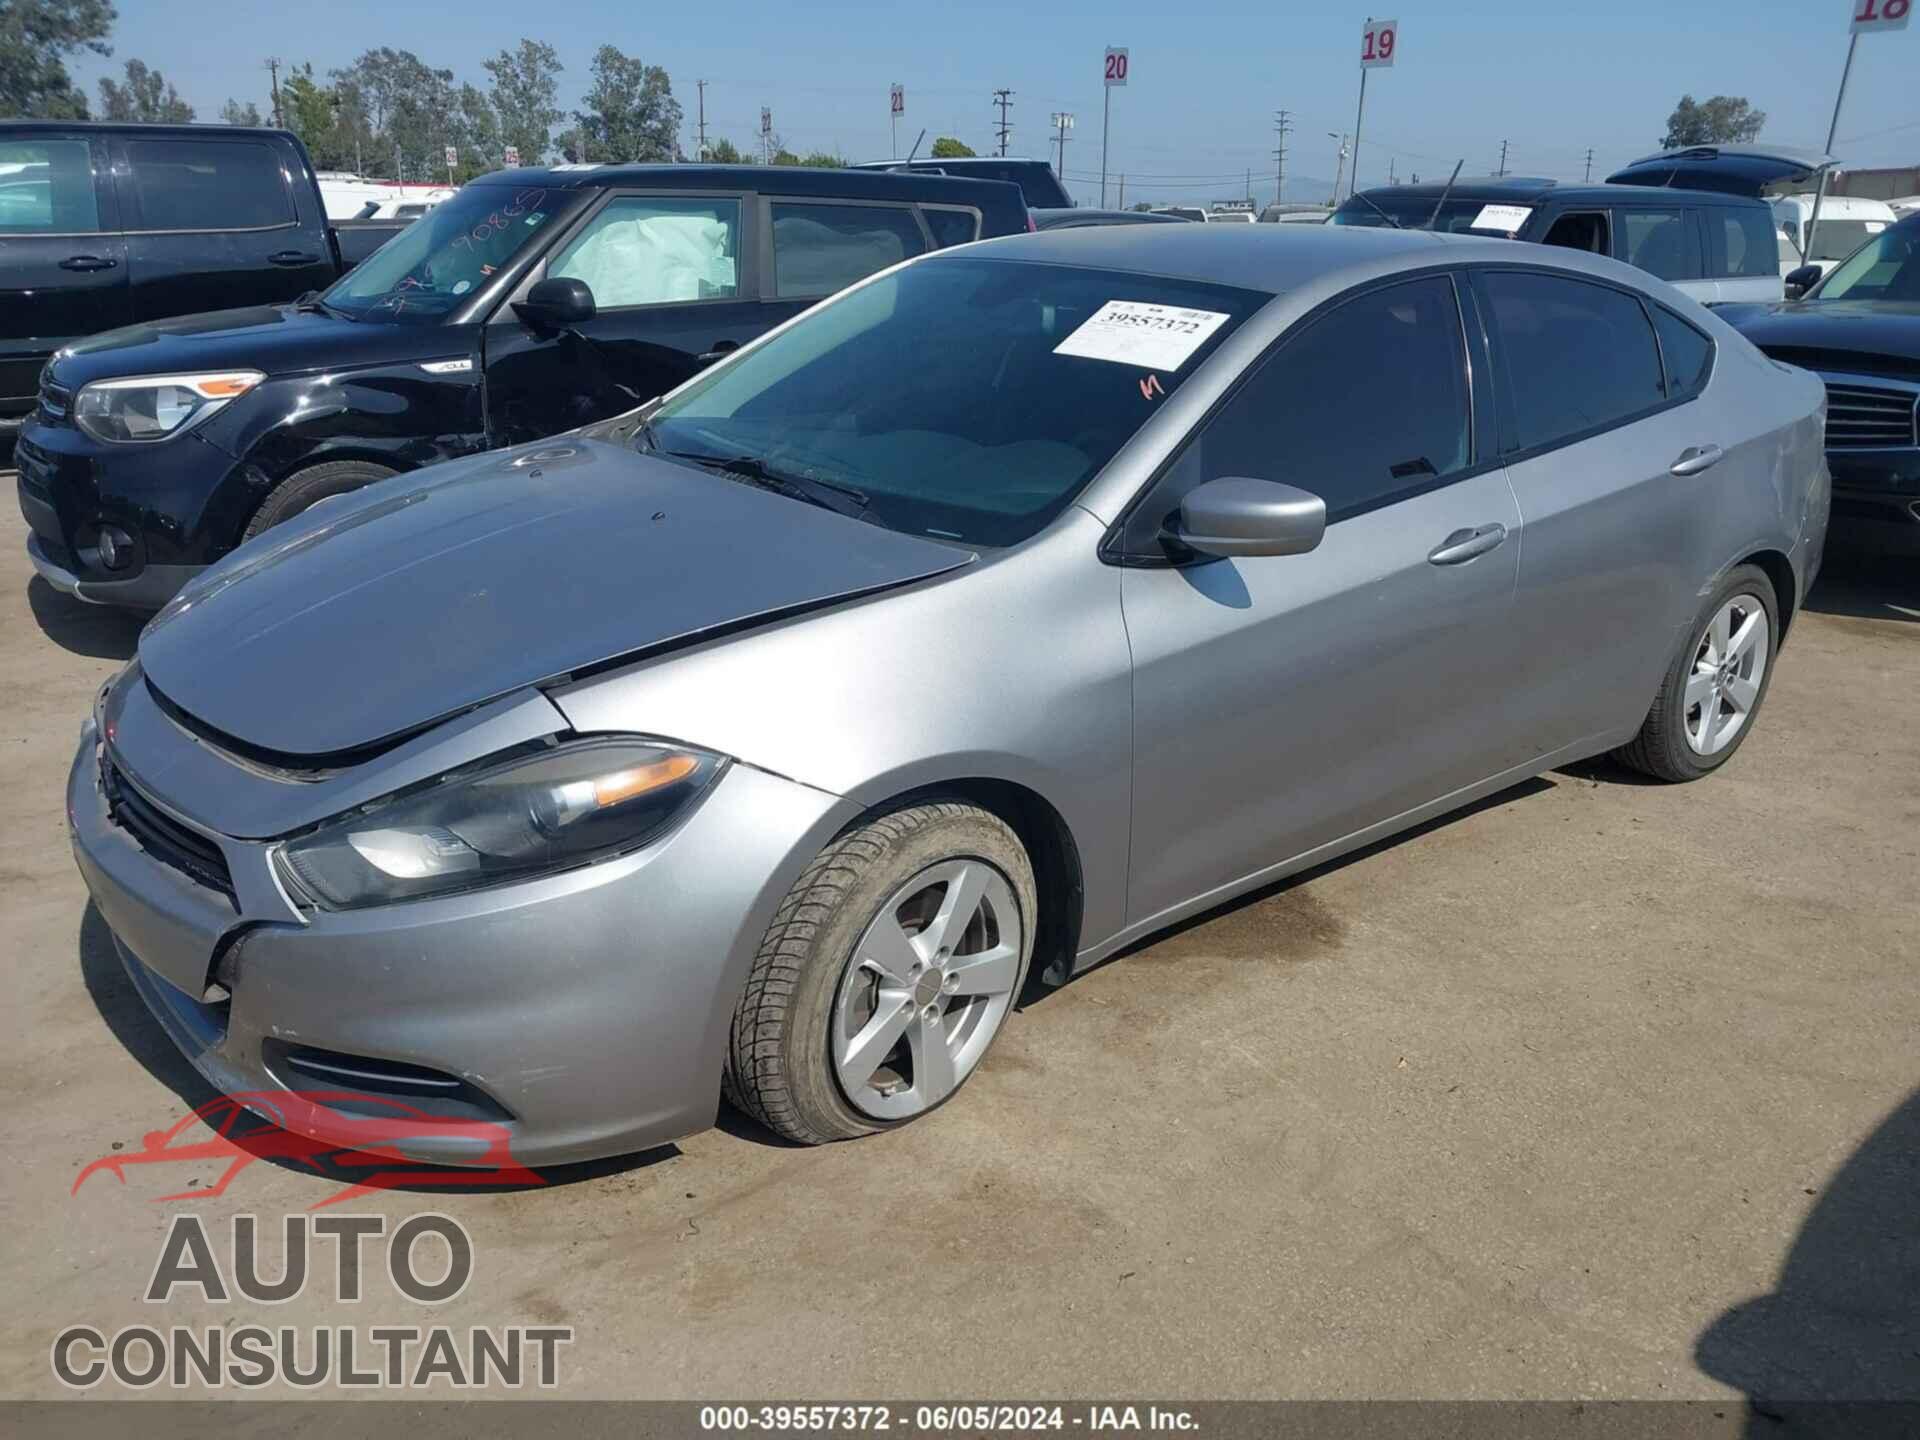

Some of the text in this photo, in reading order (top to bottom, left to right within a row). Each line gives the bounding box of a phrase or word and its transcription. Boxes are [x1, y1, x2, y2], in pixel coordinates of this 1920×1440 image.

[1362, 29, 1394, 60] 19
[1105, 54, 1128, 80] 20
[891, 92, 905, 113] 21
[1101, 311, 1201, 334] 39557372
